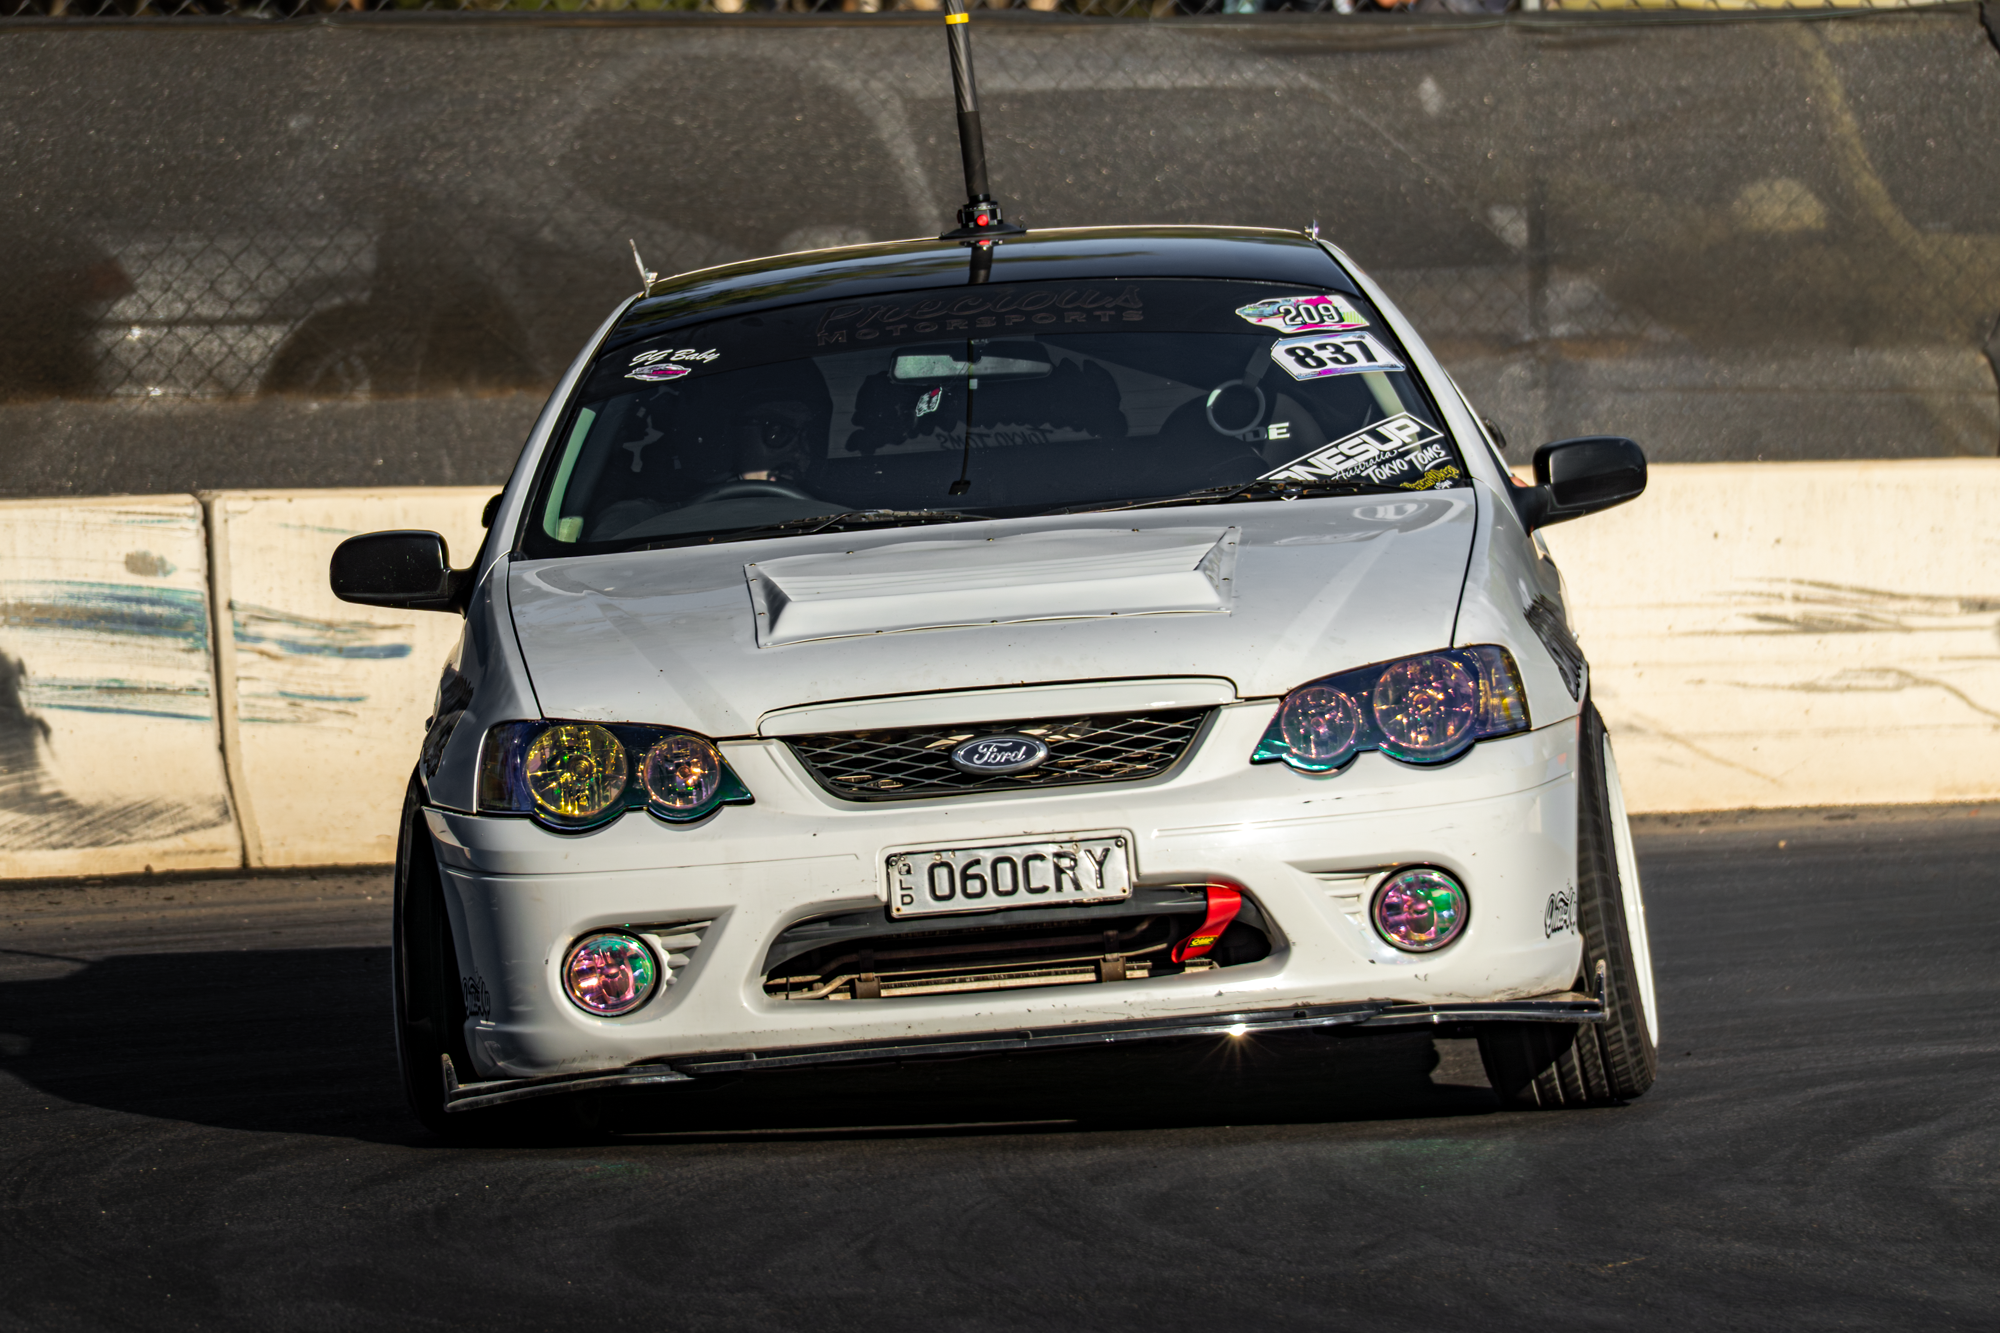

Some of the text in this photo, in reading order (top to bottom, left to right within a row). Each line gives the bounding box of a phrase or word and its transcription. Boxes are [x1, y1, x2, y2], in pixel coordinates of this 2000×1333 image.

[817, 310, 1144, 346] MOTORSPORTS
[1279, 302, 1343, 325] 209
[669, 348, 720, 363] Baby
[1284, 340, 1379, 369] 837
[1331, 449, 1398, 480] Australia
[1360, 458, 1408, 484] TOKYO
[1403, 443, 1446, 472] TOMS
[973, 742, 1027, 764] Ford
[926, 846, 1112, 902] 060CRY
